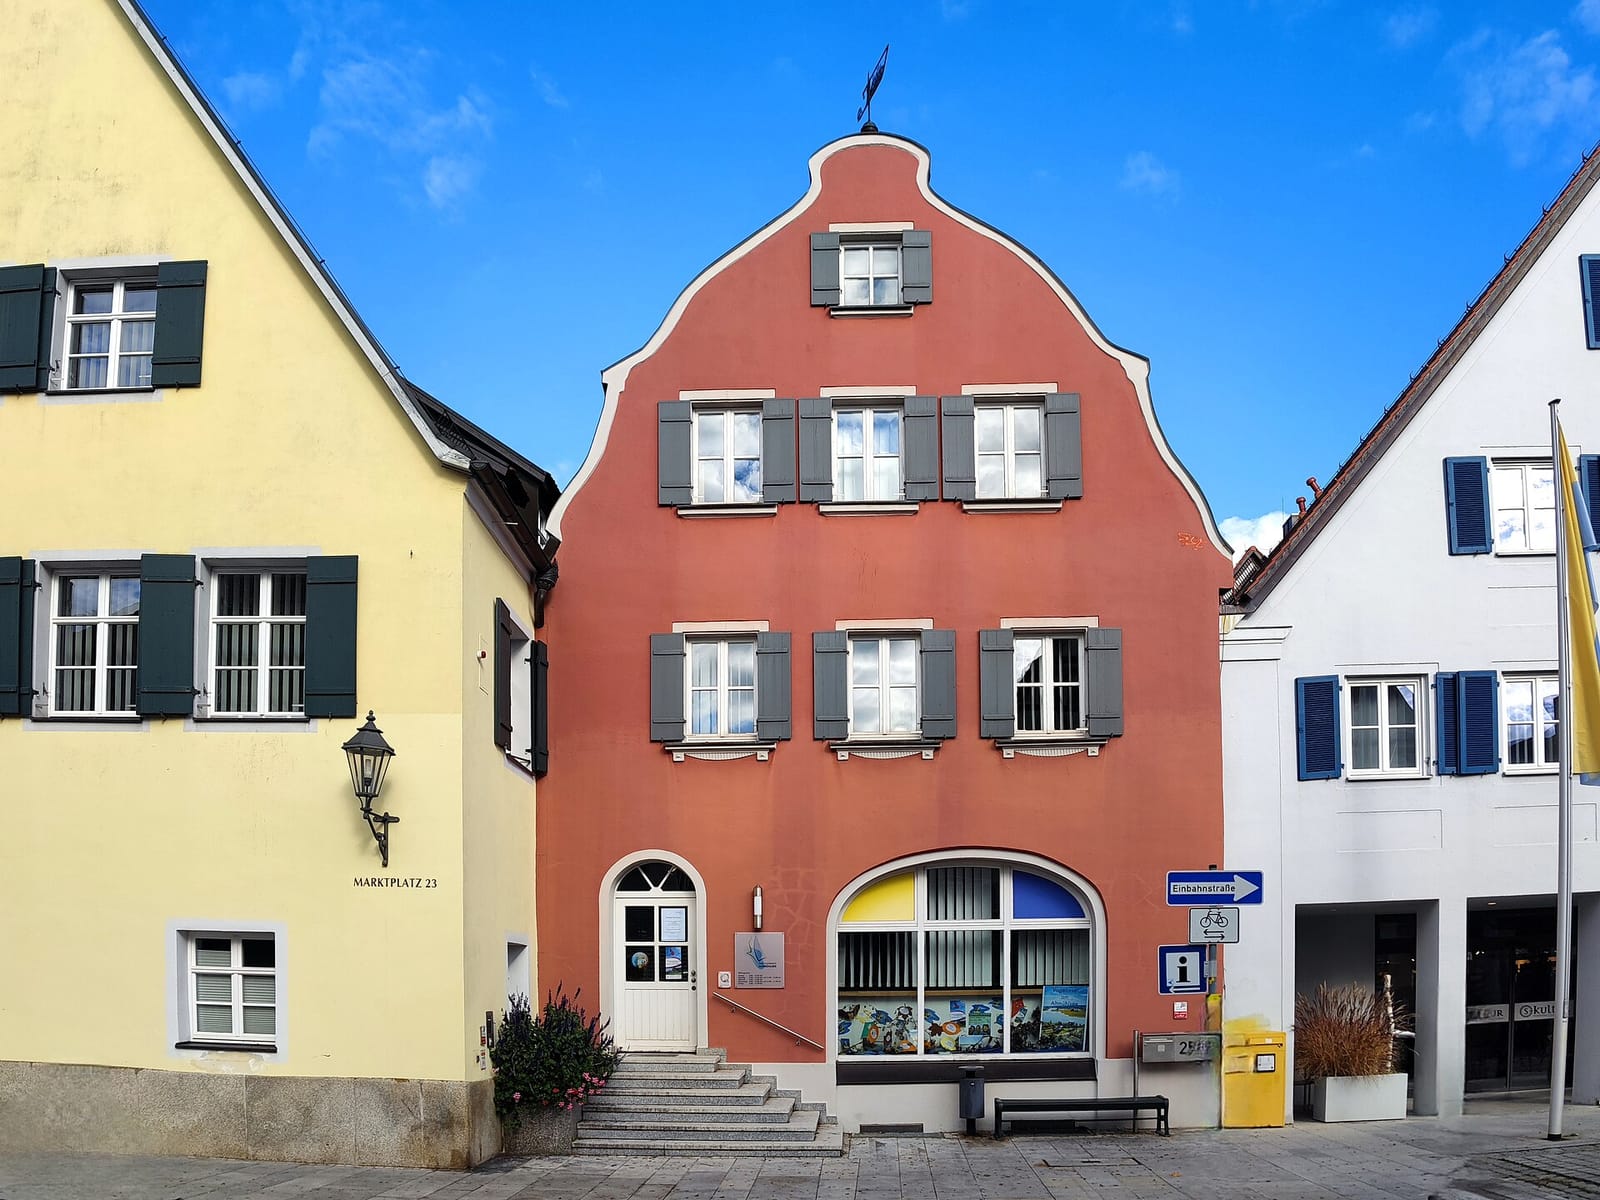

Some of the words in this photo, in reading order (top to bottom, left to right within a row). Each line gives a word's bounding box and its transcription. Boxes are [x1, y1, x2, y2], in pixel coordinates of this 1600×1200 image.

[353, 877, 422, 888] MARKTPLATZ
[425, 878, 437, 888] 23
[1172, 884, 1236, 893] Einbahnstraße
